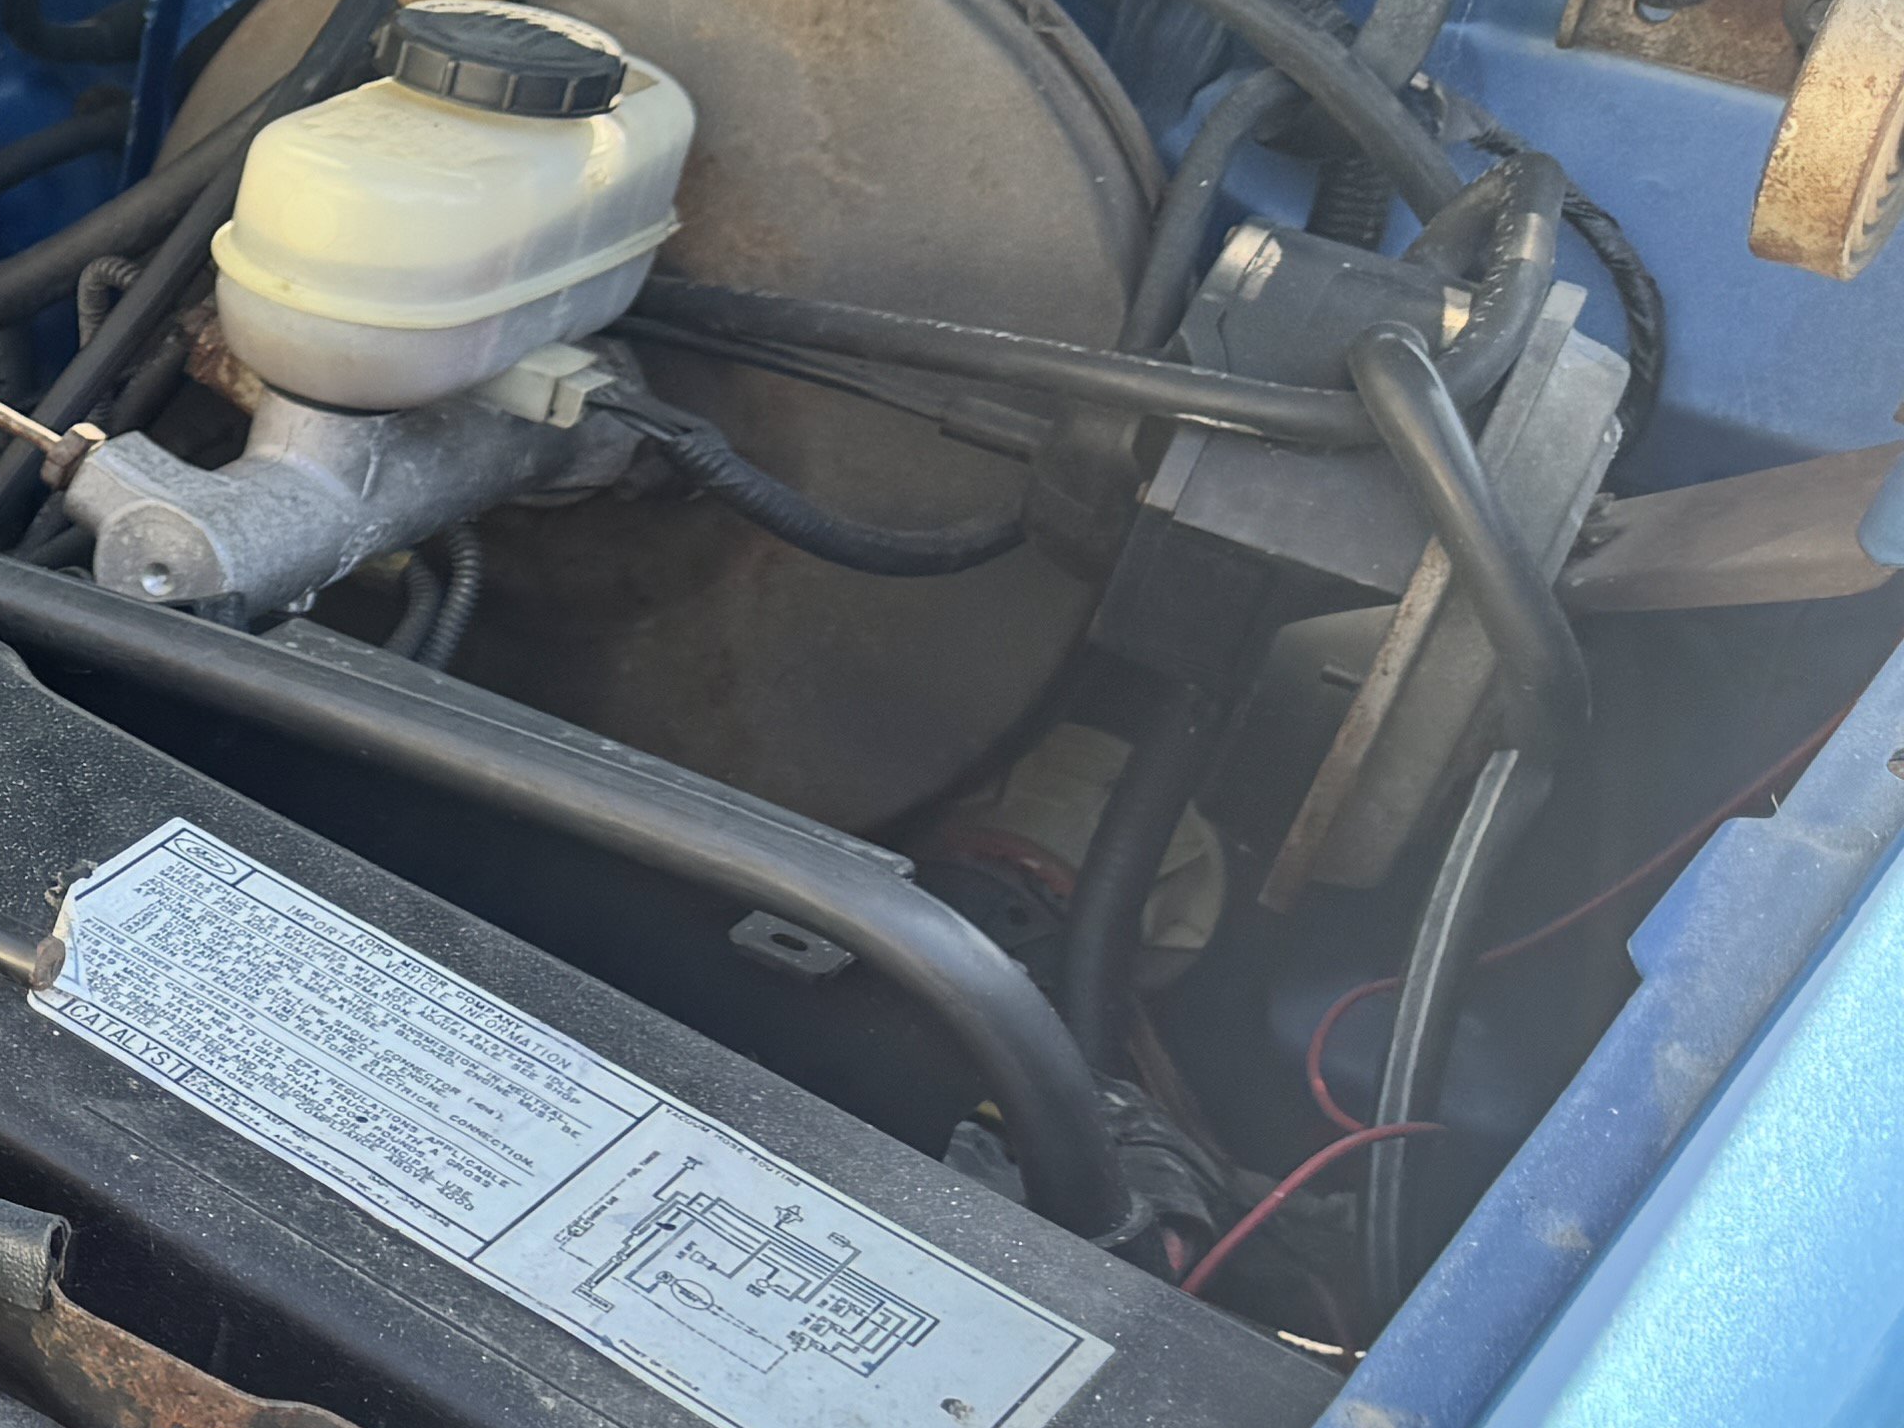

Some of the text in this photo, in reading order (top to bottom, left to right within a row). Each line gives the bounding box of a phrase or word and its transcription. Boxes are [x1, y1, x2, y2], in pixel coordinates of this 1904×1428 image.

[157, 869, 207, 898] MANUAL
[210, 900, 238, 916] FOR
[242, 918, 317, 962] ADDITIONAL
[183, 843, 229, 870] Ford
[81, 917, 128, 945] FIRING
[128, 945, 174, 972] ORDER
[131, 886, 151, 898] AT
[154, 899, 205, 929] NORMAL
[208, 930, 281, 973] OPERATING
[145, 876, 196, 906] ADJUST
[198, 907, 256, 941] IGNITION
[259, 942, 304, 969] TIMING
[308, 970, 344, 992] WITH
[348, 994, 377, 1011] THE
[381, 1012, 480, 1071] TRANSMISSION
[150, 931, 201, 962] ADJUST
[204, 962, 262, 997] IGNITION
[266, 998, 312, 1026] TIMING
[318, 1029, 338, 1042] TO
[156, 926, 224, 966] RE-START
[227, 967, 309, 1016] PREVIOUSLY
[313, 1017, 393, 1065] WARMED-UP
[164, 865, 213, 893] SPEEDS
[216, 895, 244, 911] AND
[247, 912, 277, 930] IDLE
[281, 932, 347, 970] MIXTURES
[350, 972, 378, 988] ARE
[382, 990, 411, 1008] NOT
[508, 1063, 537, 1080] SEE
[542, 1082, 582, 1106] SHOP
[167, 915, 202, 936] TURN
[204, 937, 231, 953] OFF
[172, 860, 203, 879] THIS
[207, 880, 261, 912] VEHICLE
[264, 913, 280, 923] IS
[283, 924, 348, 962] EQUIPPED
[352, 963, 387, 985] WITH
[391, 986, 420, 1003] EEC
[544, 1074, 578, 1094] IDLE
[285, 905, 573, 1070] IMPORTANT VEHICLE INFORMATION
[354, 933, 524, 1032] FORD MOTOR COMPANY
[67, 1002, 187, 1076] CATALYST
[98, 995, 155, 1029] SERVICE
[105, 947, 160, 980] VEHICLE
[162, 980, 232, 1022] CONFORMS
[236, 1023, 257, 1037] TO
[293, 1058, 323, 1077] EPA
[325, 1077, 419, 1134] REGULATIONS
[423, 1134, 511, 1188] APPLICABLE
[109, 970, 161, 1001] WEIGHT
[162, 1001, 214, 1032] RATING
[215, 1032, 278, 1070] GREATER
[281, 1072, 319, 1095] THAN
[120, 966, 165, 993] MODEL
[168, 994, 203, 1015] YEAR
[206, 1016, 236, 1035] NEW
[238, 1035, 323, 1087] LIGHT-DUTY
[327, 1088, 381, 1122] TRUCKS
[386, 1123, 423, 1146] WITH
[428, 1147, 441, 1156] A
[443, 1158, 493, 1188] GROSS
[138, 881, 193, 913] PARKING
[196, 914, 239, 940] BRAKE
[242, 941, 271, 959] SET
[274, 959, 301, 976] AND
[305, 977, 334, 995] THE
[336, 995, 390, 1027] WHEELS
[462, 1068, 511, 1098] ENGINE
[515, 1099, 555, 1124] MUST
[559, 1125, 582, 1139] BE
[143, 936, 178, 957] TURN
[180, 958, 208, 974] OFF
[211, 975, 259, 1004] ENGINE
[262, 1005, 290, 1022] AND
[293, 1023, 356, 1061] RESTORE
[359, 1062, 443, 1113] ELECTRICAL
[161, 920, 239, 967] DISCONNECT
[244, 968, 272, 985] THE
[275, 986, 328, 1018] IN-LINE
[332, 1018, 379, 1047] SPOUT
[382, 1048, 461, 1096] CONNECTOR
[125, 990, 227, 1051] DEMONSTRATED
[231, 1052, 259, 1070] AND
[261, 1071, 328, 1112] DESIGNED
[329, 1112, 361, 1131] FOR
[362, 1131, 441, 1180] PRINCIPAL
[166, 1024, 196, 1043] FOR
[199, 1044, 231, 1064] NEW
[233, 1064, 290, 1100] VEHICLE
[294, 1101, 379, 1153] COMPLIANCE
[381, 1153, 430, 1184] ABOVE
[434, 1186, 475, 1212] 4000
[664, 1106, 801, 1187] VACUUM HOSE ROUTING
